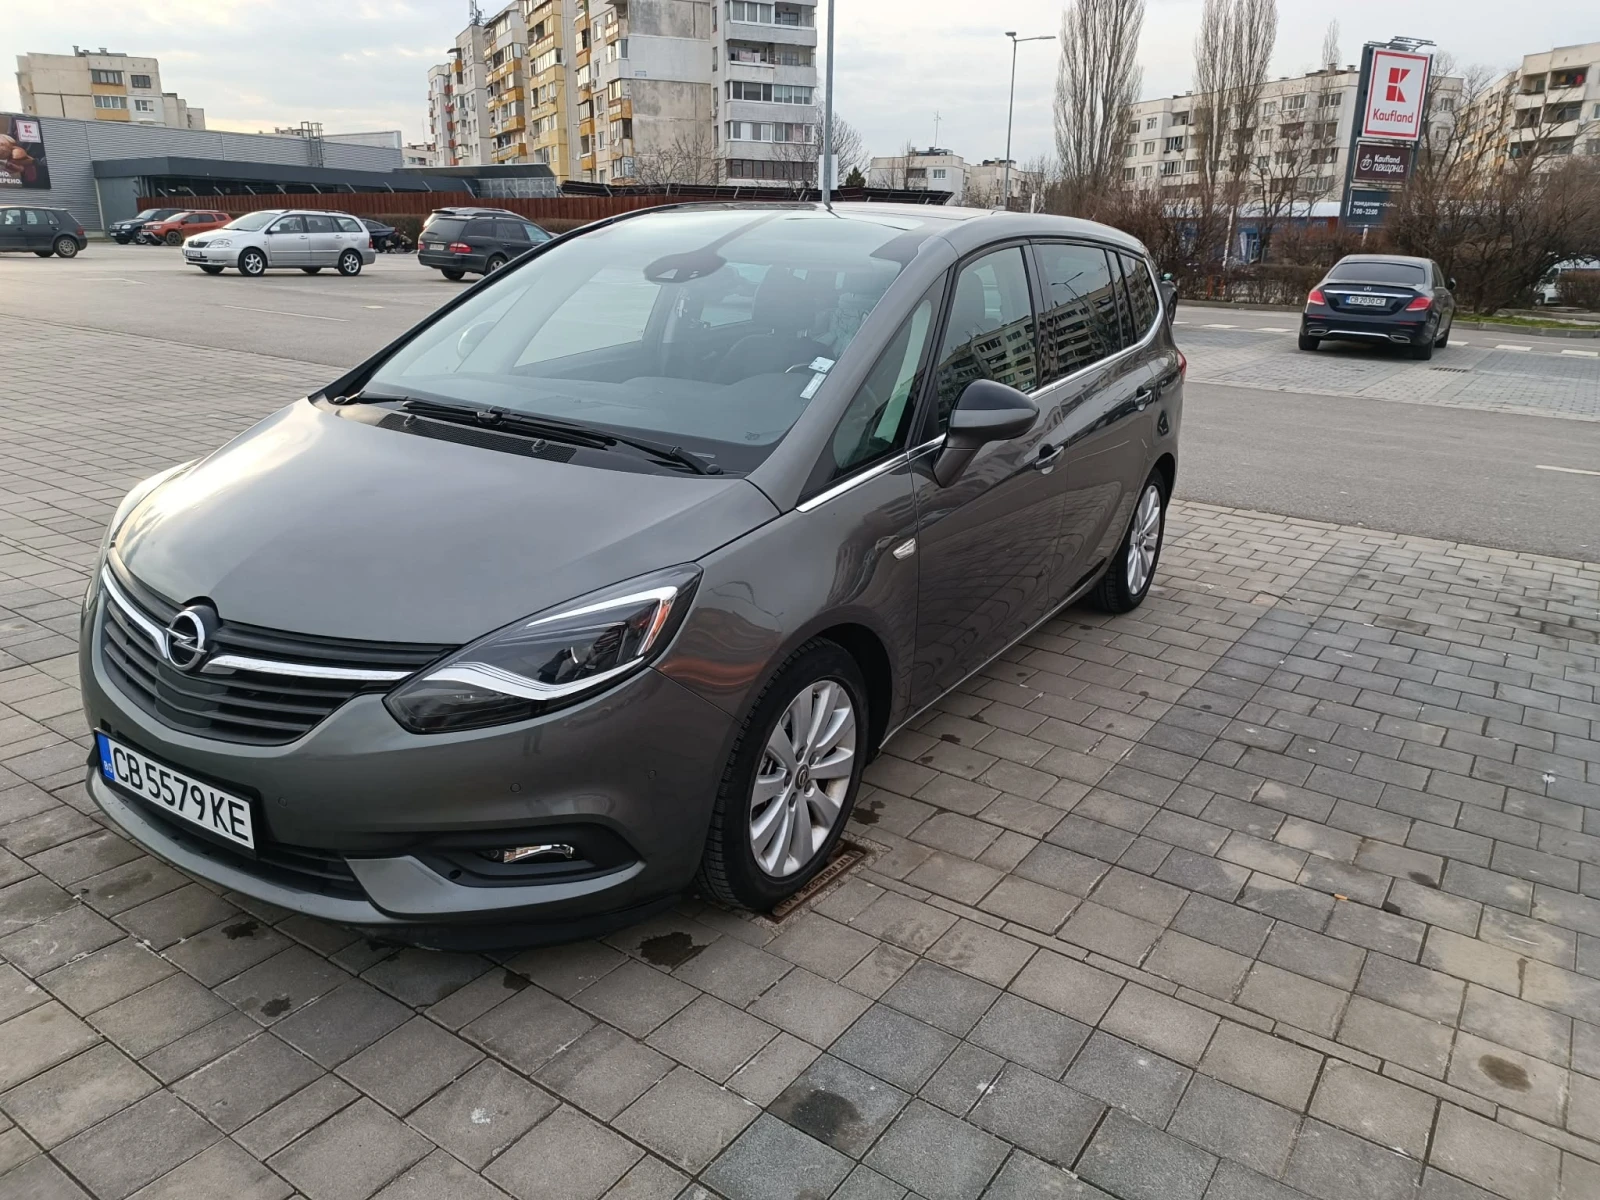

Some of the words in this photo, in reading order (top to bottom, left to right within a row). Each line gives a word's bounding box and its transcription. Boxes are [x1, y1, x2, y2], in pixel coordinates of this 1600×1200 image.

[1372, 108, 1414, 124] Kaufland
[1374, 153, 1401, 164] Kaufland
[104, 760, 113, 773] BG
[145, 762, 206, 821] 5579
